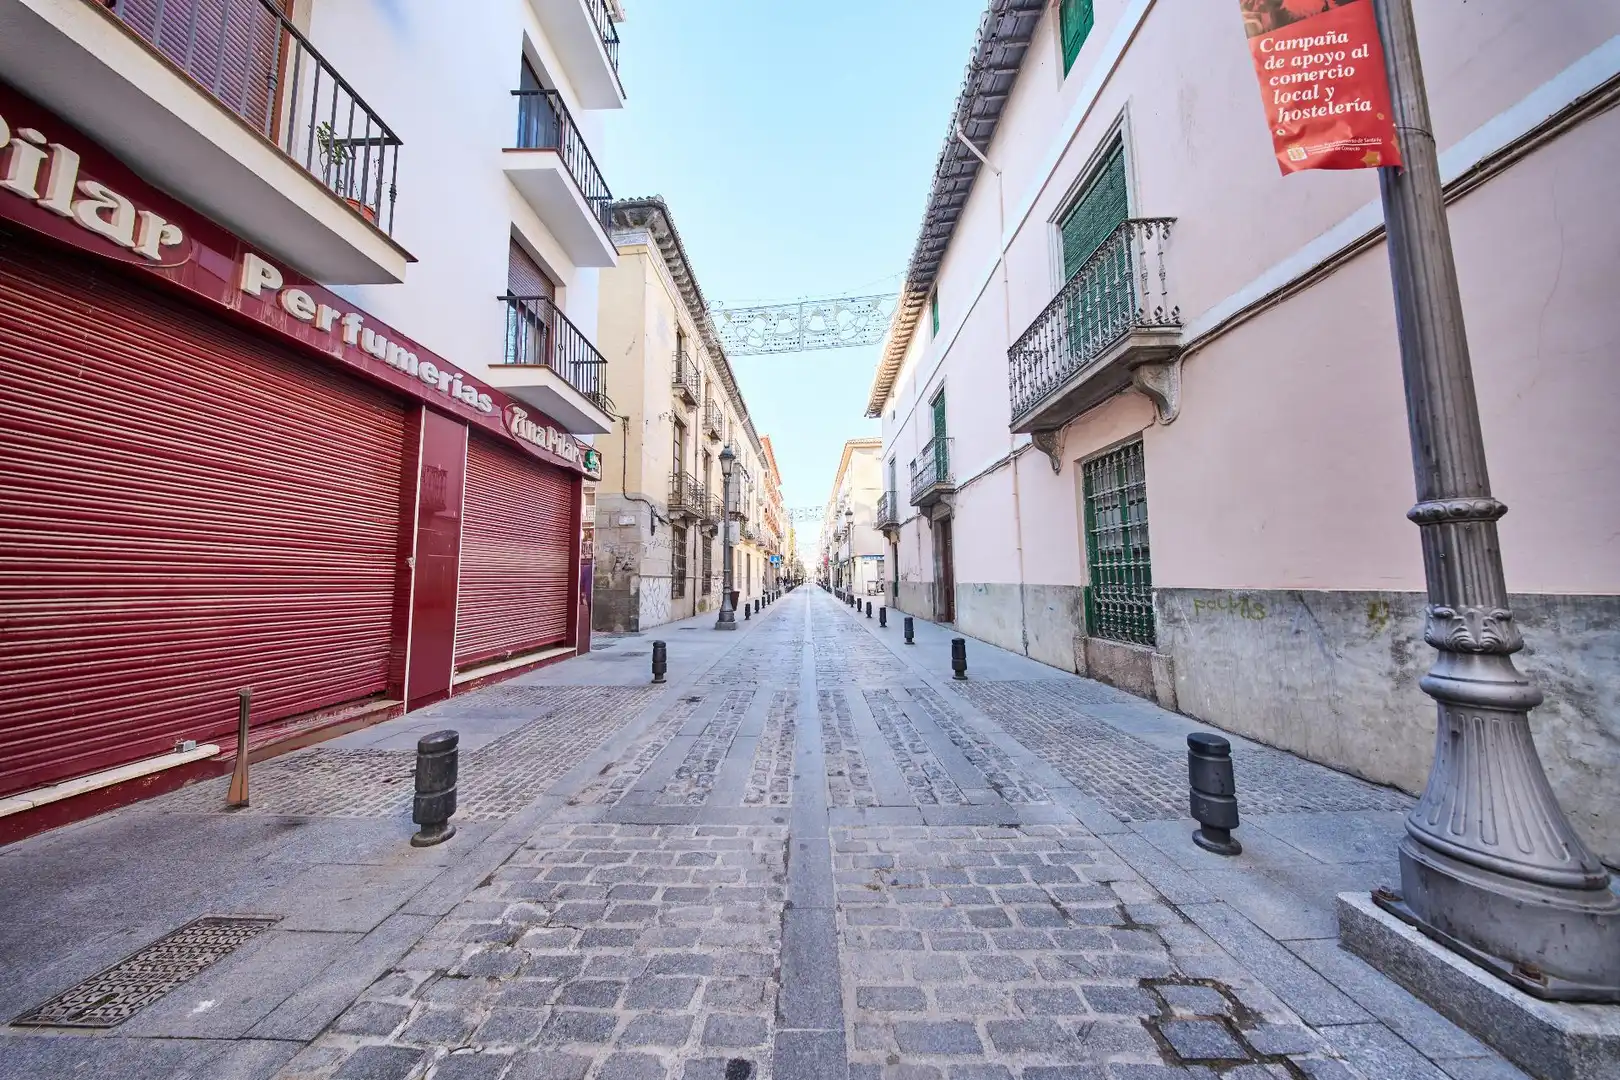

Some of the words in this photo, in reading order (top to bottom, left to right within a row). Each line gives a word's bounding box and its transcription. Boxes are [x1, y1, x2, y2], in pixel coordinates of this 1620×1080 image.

[1259, 31, 1349, 53] Campaña
[1264, 56, 1285, 71] de
[1291, 49, 1346, 69] apoyo
[1351, 44, 1369, 59] al
[1269, 65, 1355, 86] comercio
[1273, 85, 1320, 105] local
[1324, 85, 1335, 102] y
[1277, 97, 1372, 123] hostelería
[241, 252, 493, 413] Perfumerías
[546, 425, 580, 463] Pilar
